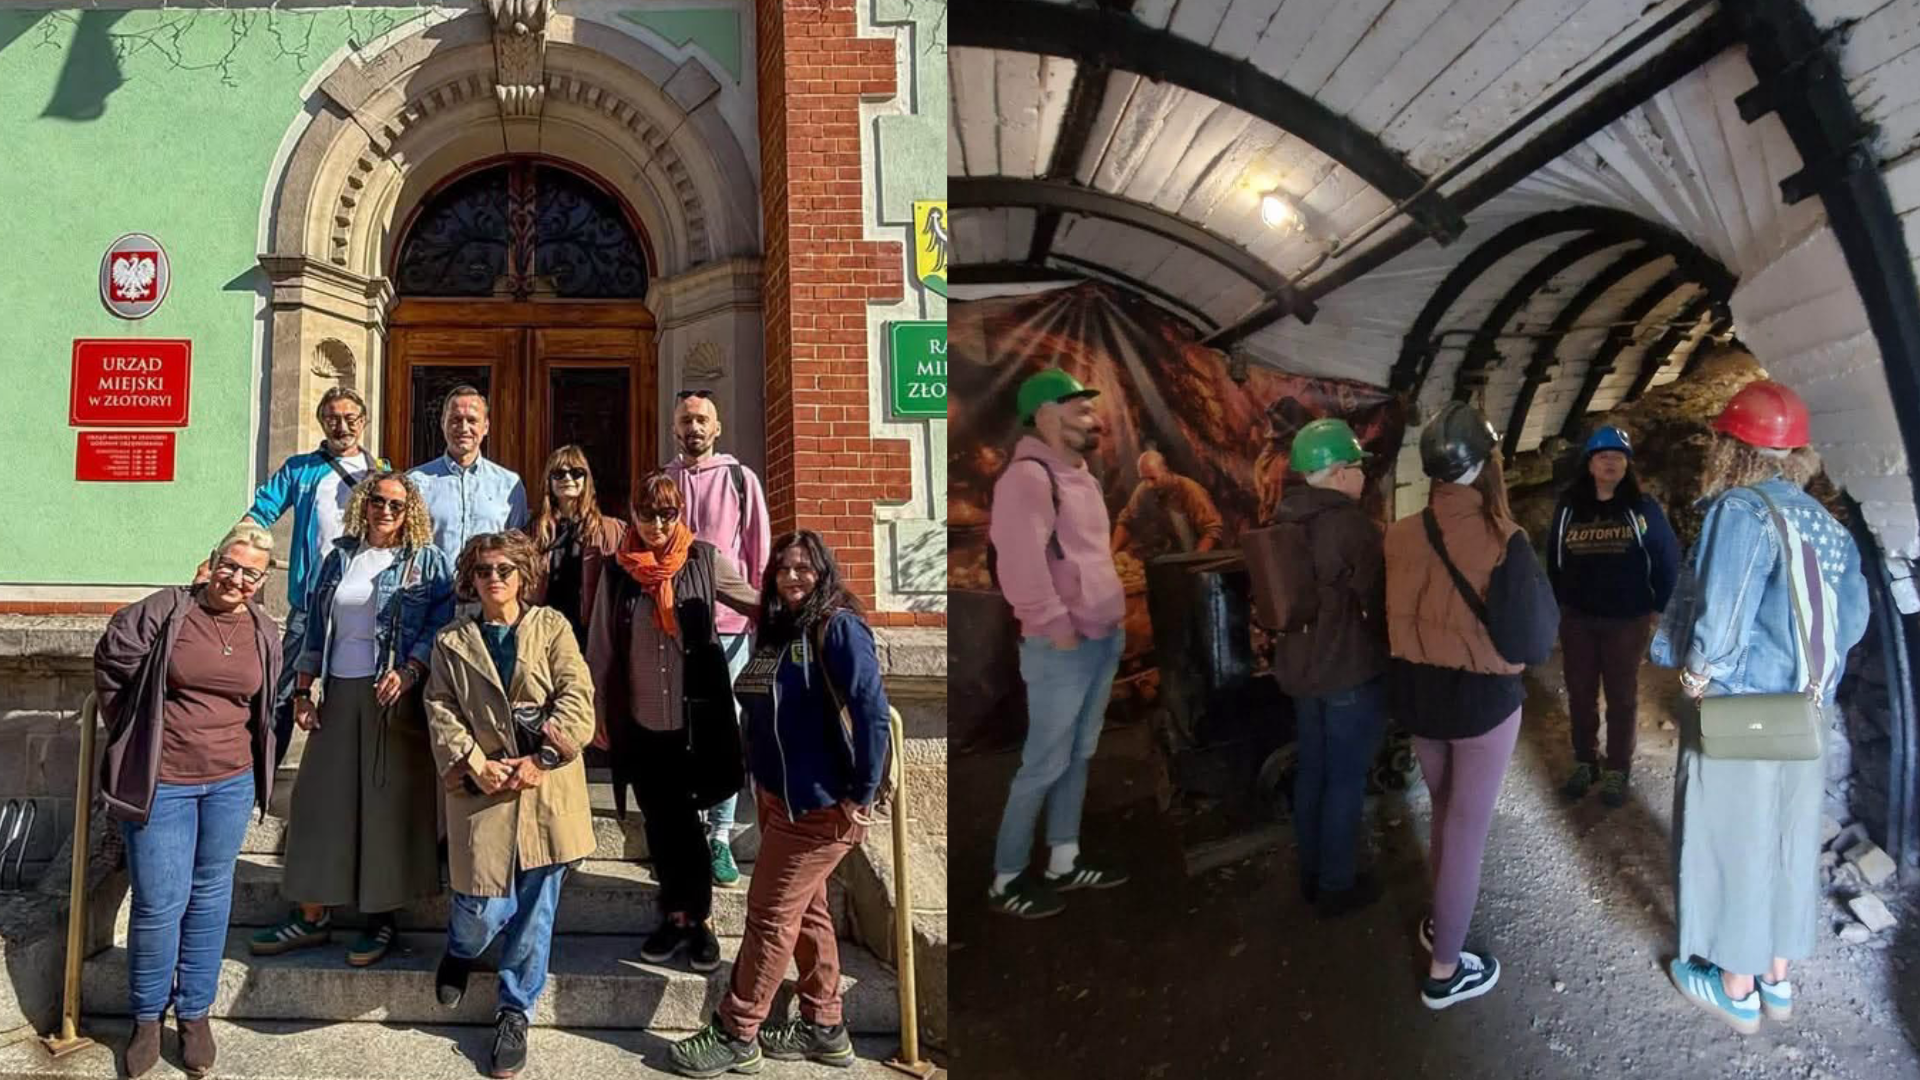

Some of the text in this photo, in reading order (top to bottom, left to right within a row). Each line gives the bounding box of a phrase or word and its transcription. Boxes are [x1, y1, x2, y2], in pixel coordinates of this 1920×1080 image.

[103, 357, 163, 374] URZĄD
[917, 360, 947, 376] MI
[98, 377, 163, 393] MIEJSKI
[908, 382, 947, 398] ZŁO
[103, 395, 171, 406] ZŁOTORYI
